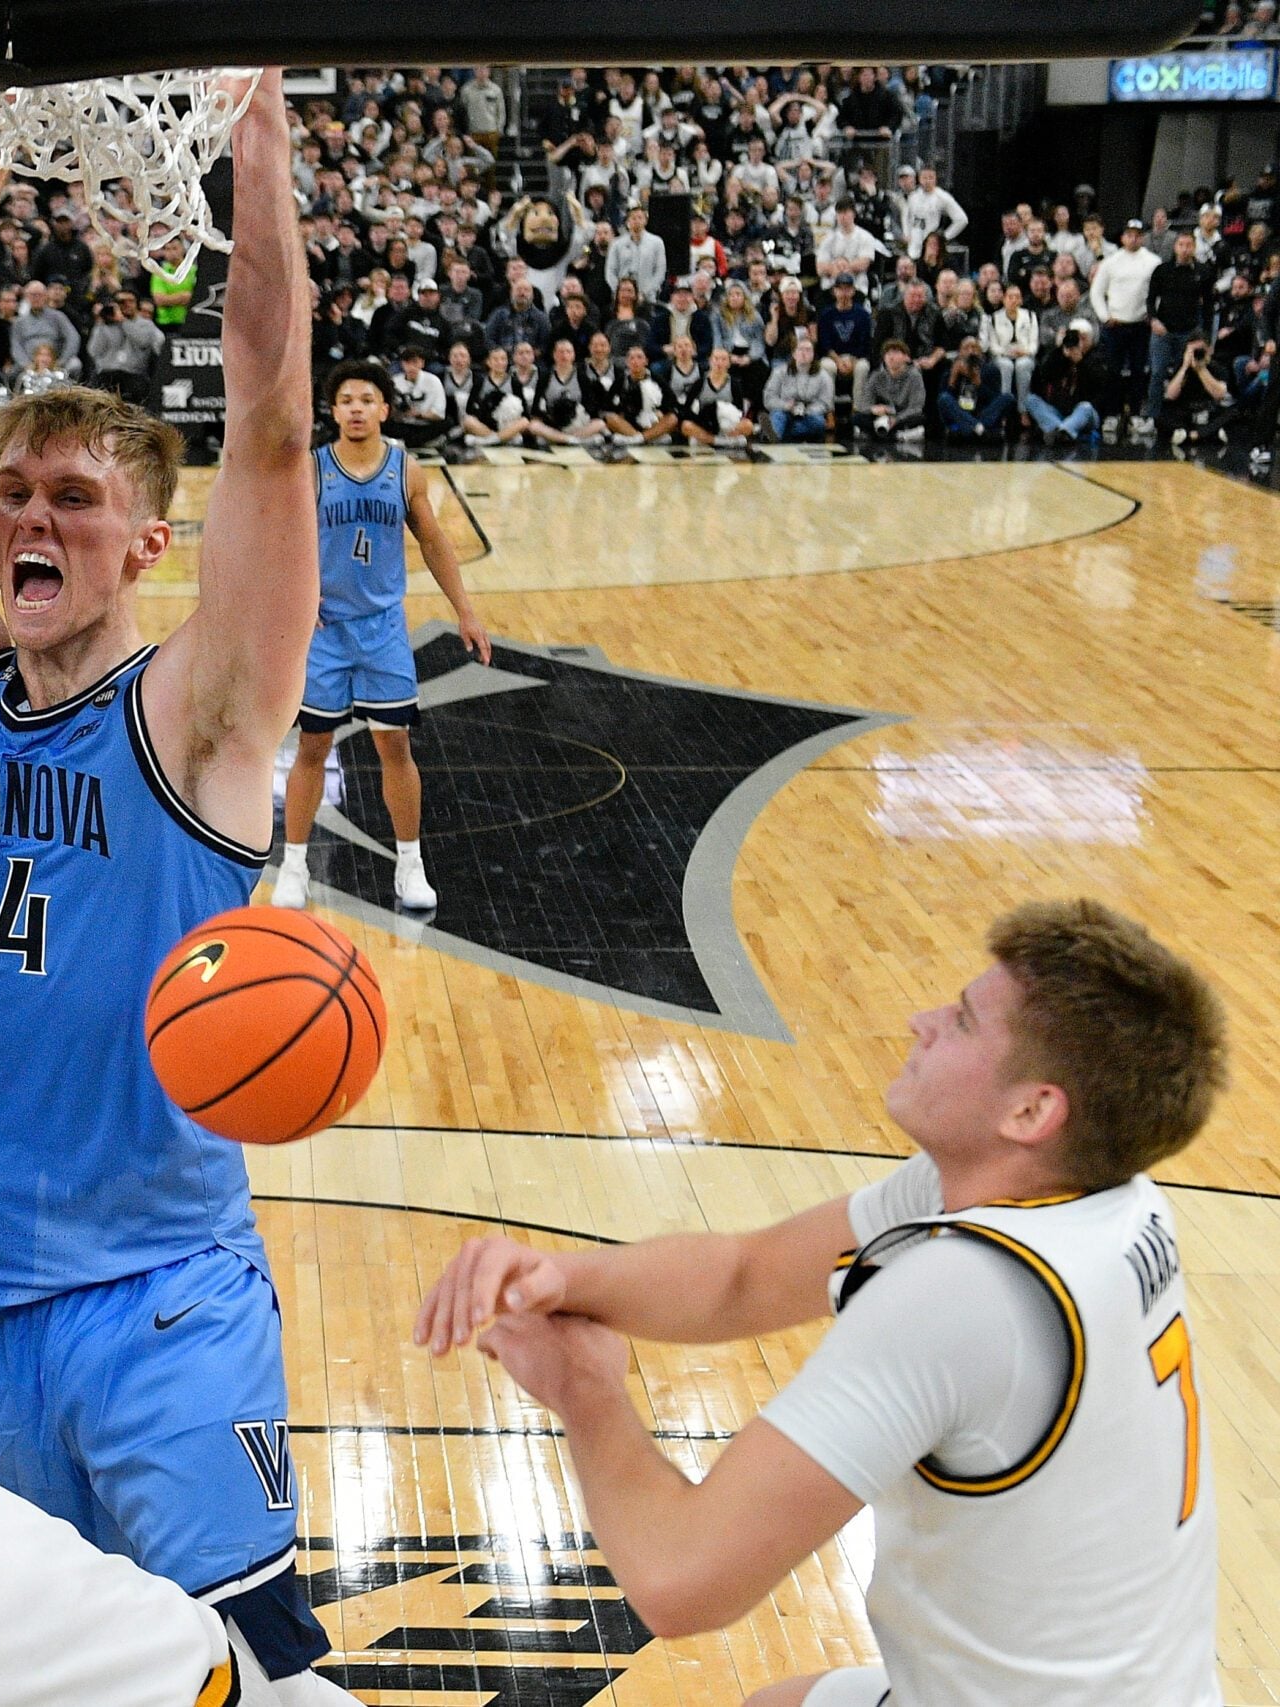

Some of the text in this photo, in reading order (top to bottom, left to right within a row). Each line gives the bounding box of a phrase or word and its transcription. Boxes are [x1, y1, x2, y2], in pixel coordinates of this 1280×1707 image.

[1116, 61, 1268, 92] COX Mobile
[324, 498, 398, 529] VILLANOVA
[351, 527, 373, 567] 4
[1148, 1310, 1201, 1530] 7
[232, 1418, 294, 1512] V
